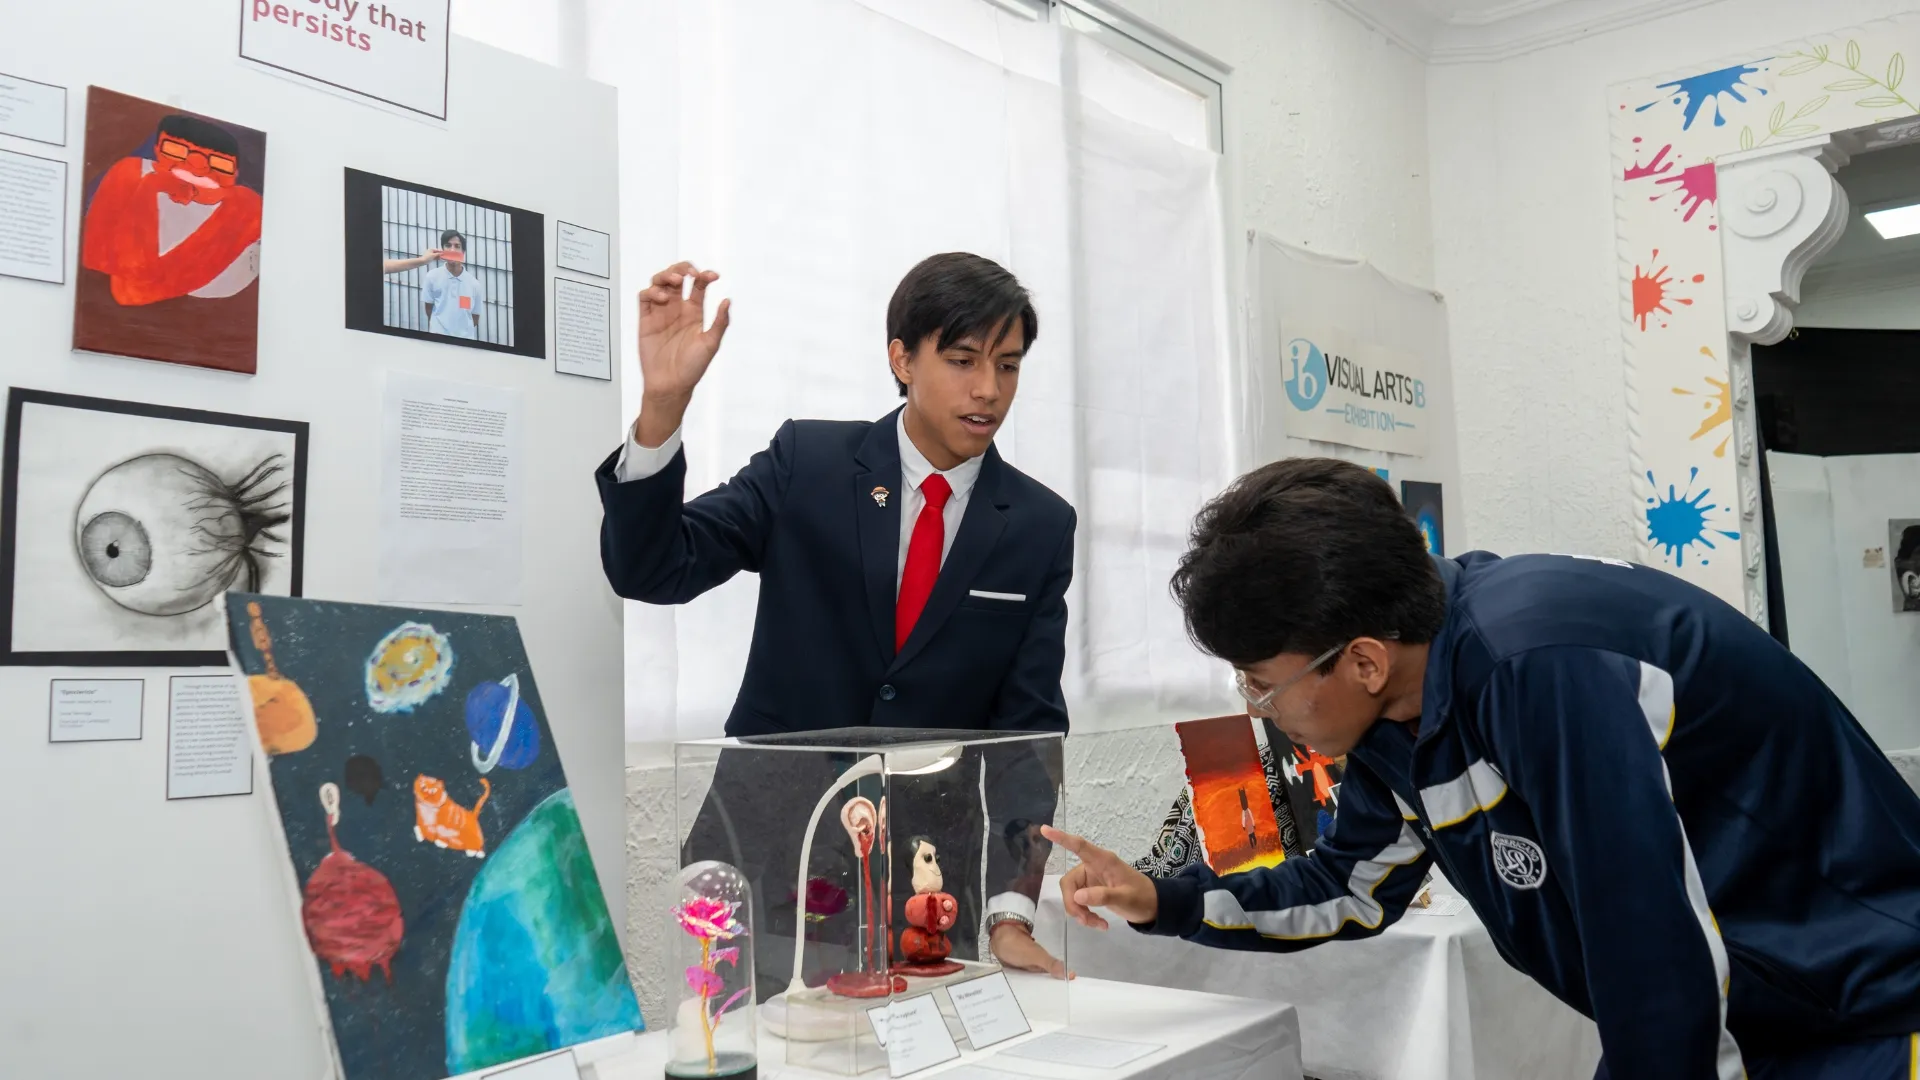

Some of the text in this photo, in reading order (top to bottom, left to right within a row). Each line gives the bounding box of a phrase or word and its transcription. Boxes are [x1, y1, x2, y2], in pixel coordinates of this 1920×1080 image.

[252, 0, 371, 51] persists
[367, 3, 426, 42] that
[1324, 353, 1371, 398] VISUAL
[1373, 370, 1414, 405] ARTS
